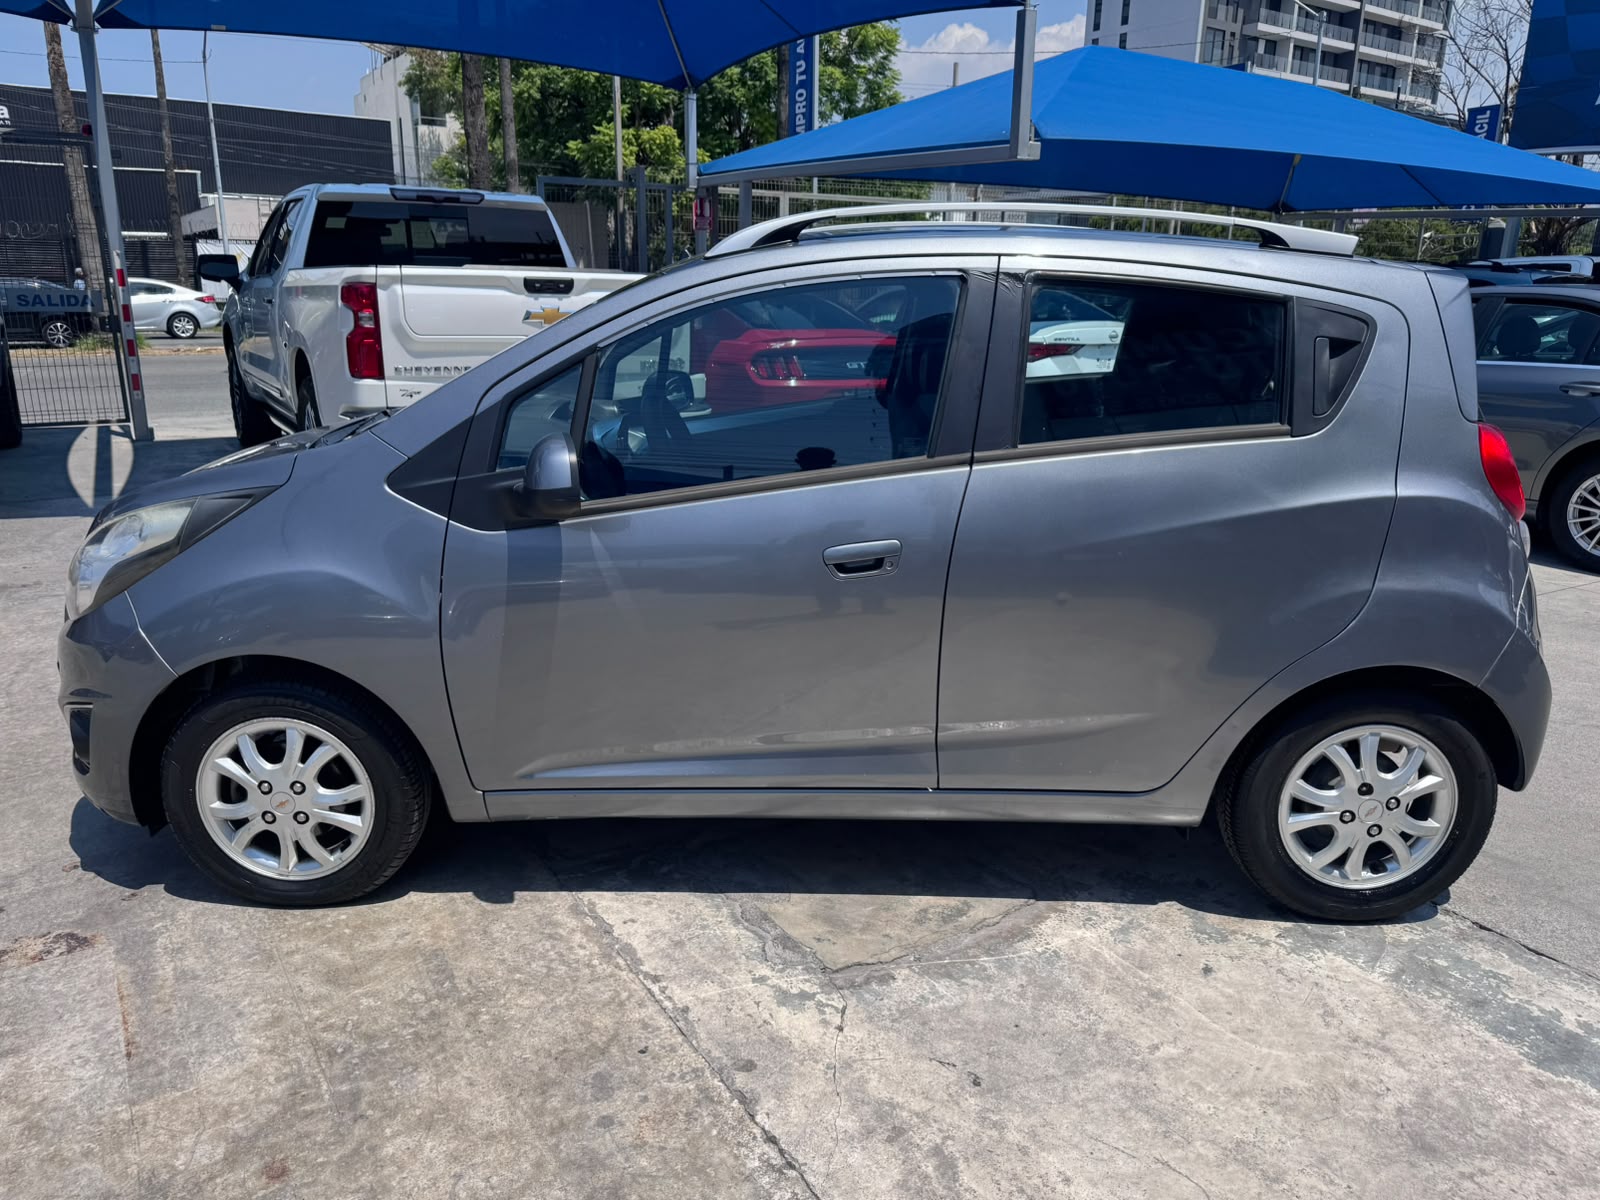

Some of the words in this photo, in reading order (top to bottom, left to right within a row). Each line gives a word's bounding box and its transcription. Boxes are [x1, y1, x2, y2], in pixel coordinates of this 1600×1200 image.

[796, 38, 805, 54] A
[795, 60, 807, 85] TU
[17, 294, 95, 307] SALIDA
